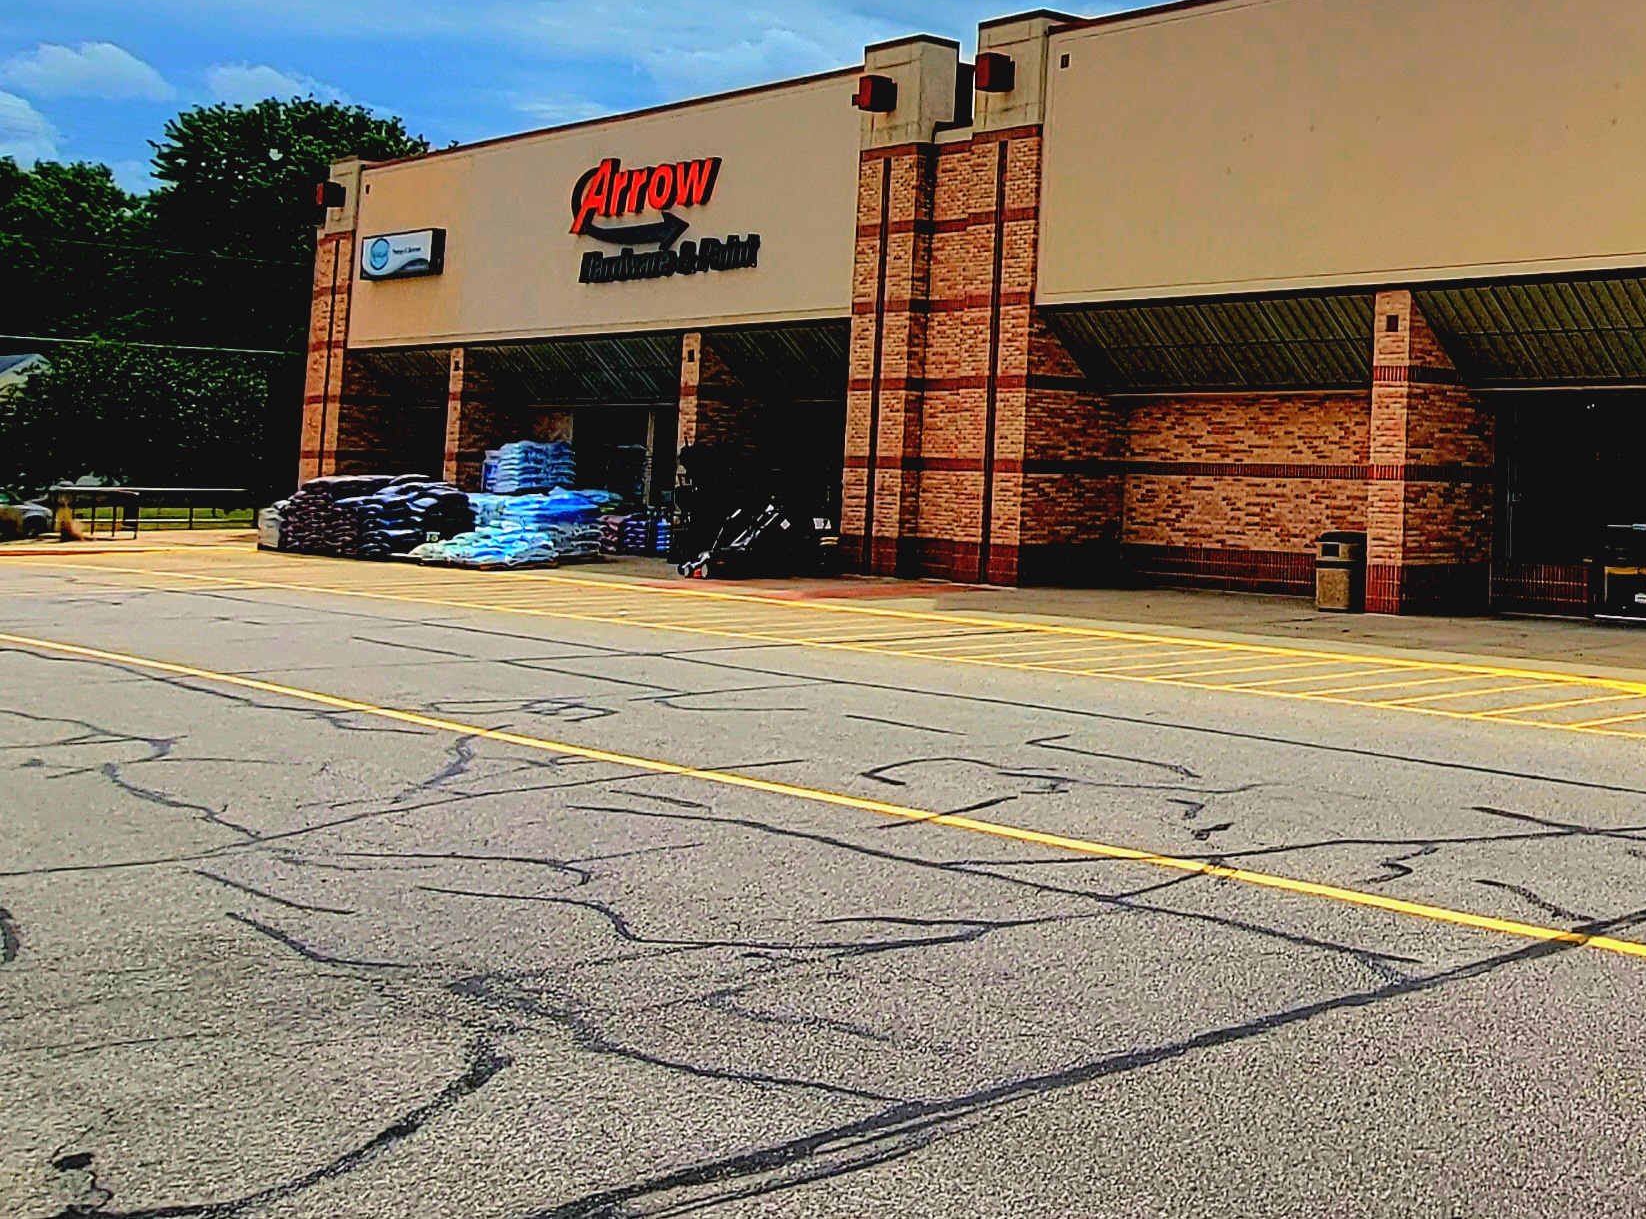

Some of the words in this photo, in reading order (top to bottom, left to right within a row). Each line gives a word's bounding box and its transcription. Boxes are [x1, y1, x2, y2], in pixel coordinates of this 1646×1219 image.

[569, 157, 722, 234] Arrow
[579, 247, 677, 283] Hardware
[699, 233, 760, 272] Paint
